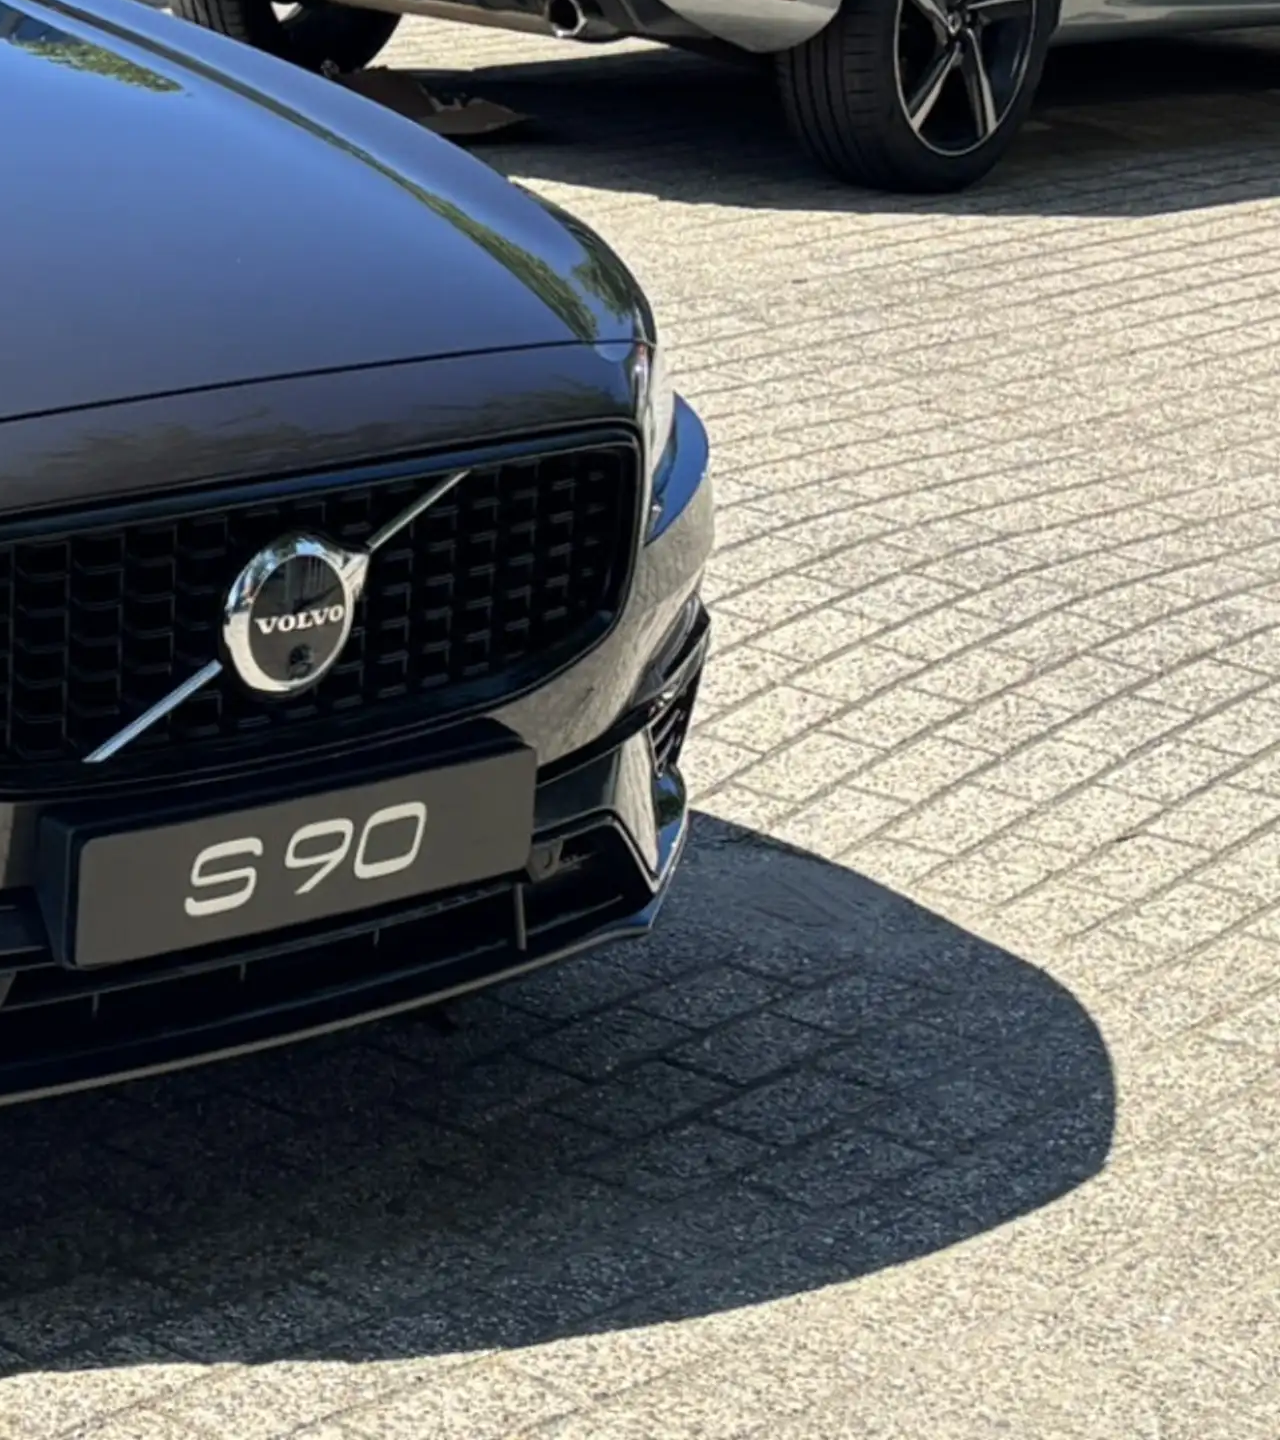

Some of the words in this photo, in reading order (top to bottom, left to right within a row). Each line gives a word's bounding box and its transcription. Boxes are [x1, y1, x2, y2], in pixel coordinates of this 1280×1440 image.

[254, 604, 345, 635] VOLVO
[184, 836, 264, 918] S
[284, 800, 428, 895] 90
